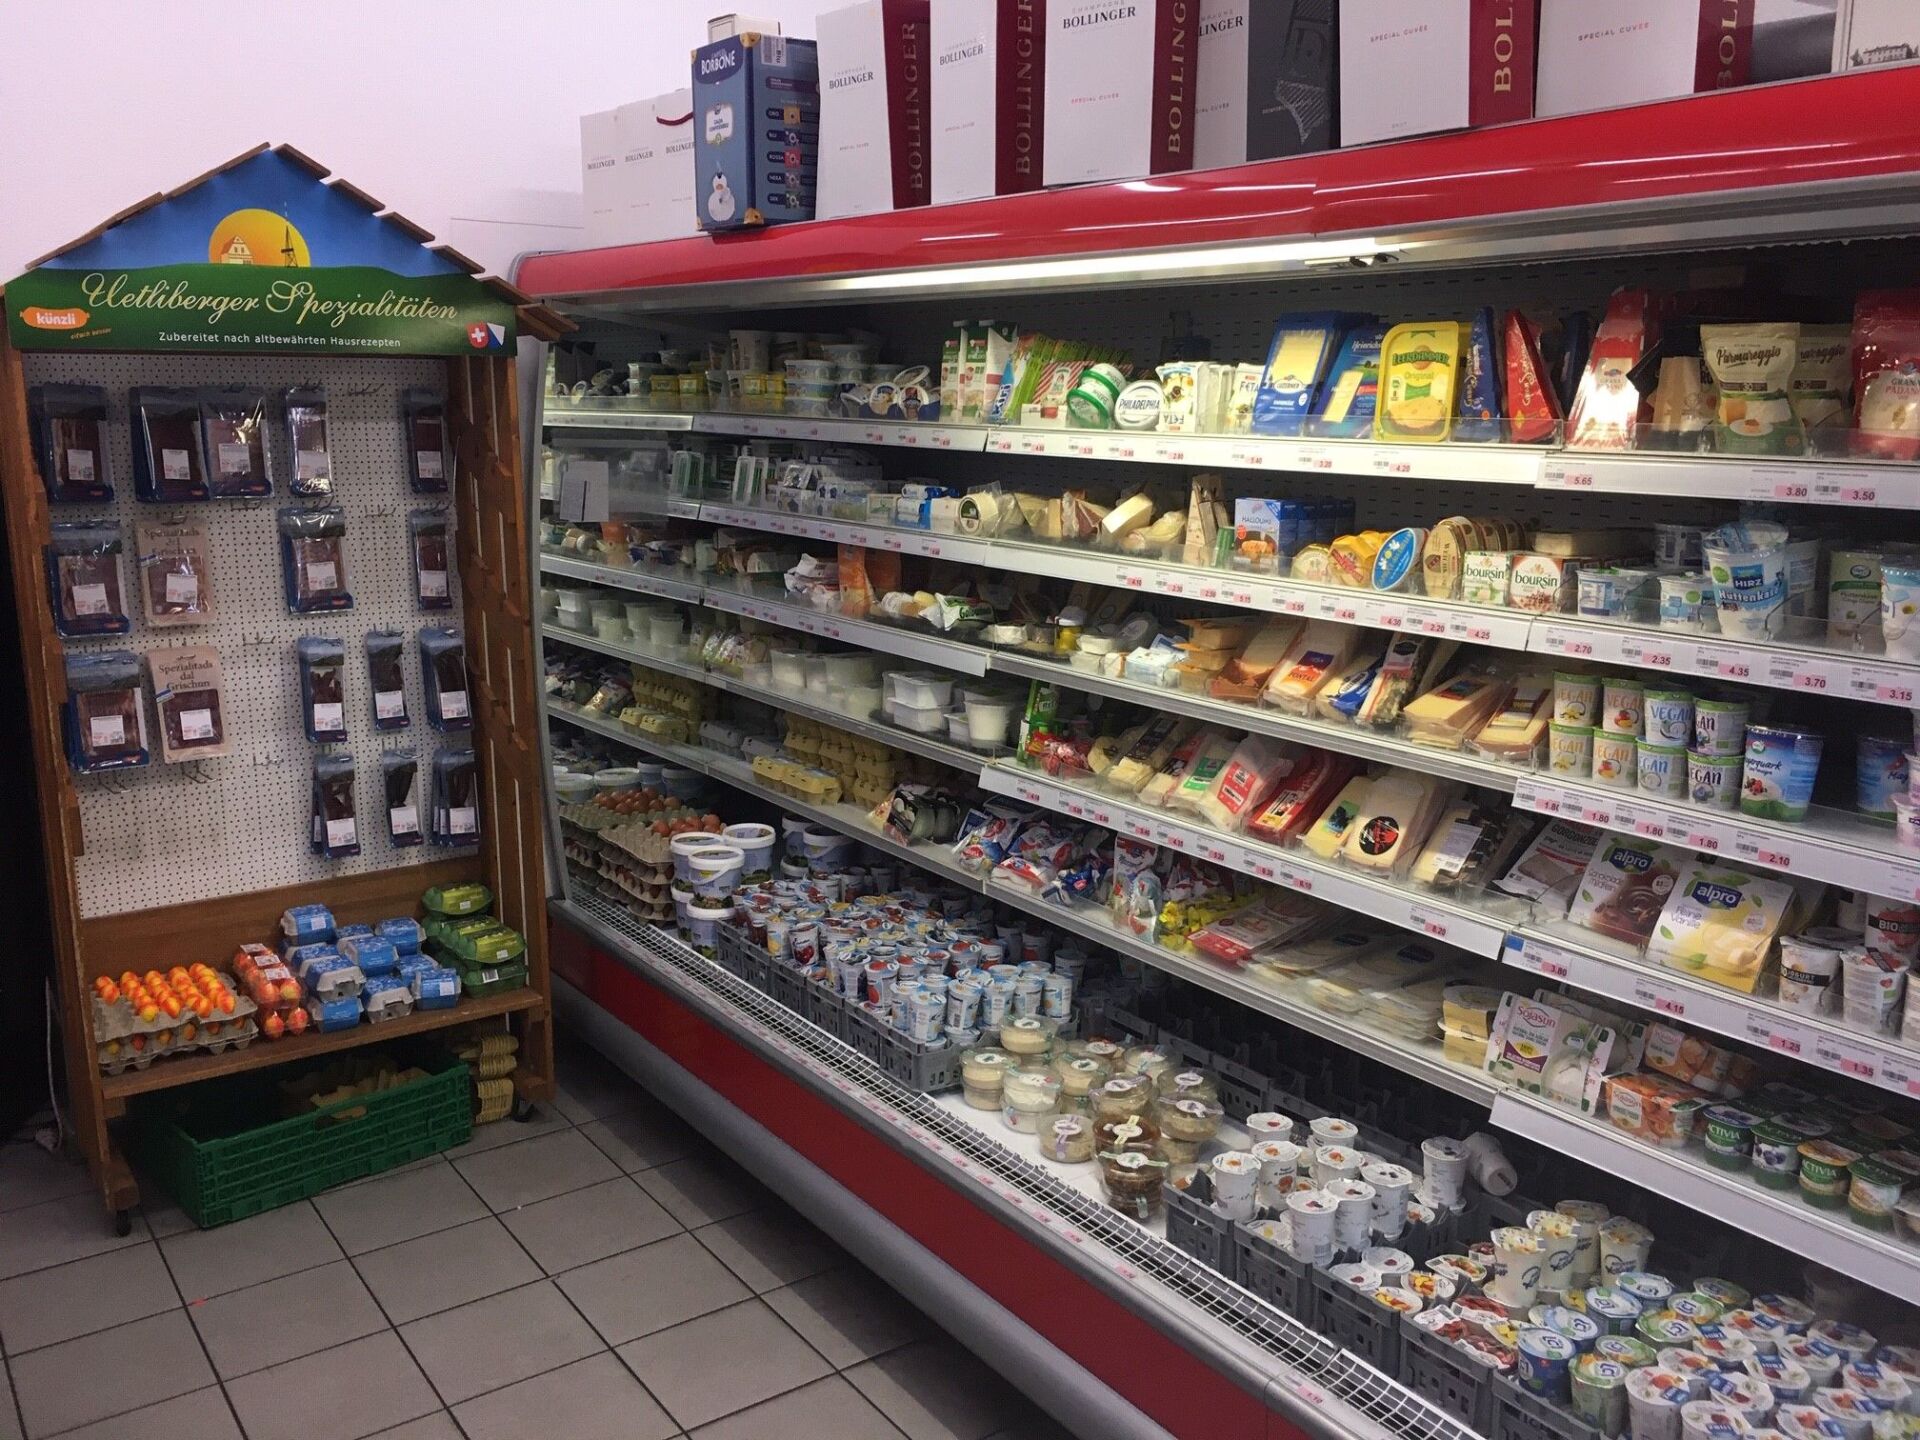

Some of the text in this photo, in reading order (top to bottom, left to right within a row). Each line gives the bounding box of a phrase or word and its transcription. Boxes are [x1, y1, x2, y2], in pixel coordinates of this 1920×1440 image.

[1063, 6, 1136, 29] BOLLINGER
[939, 44, 984, 66] BOLLINGER
[702, 50, 736, 75] BORBONE
[829, 71, 874, 90] BOLLINGER
[902, 22, 923, 189] BOLLINGER
[81, 272, 458, 329] Uetliberger Spezialitäten
[36, 312, 76, 326] künzli
[159, 332, 401, 349] Zubereitet nach altbewährten Hausrezepten
[1118, 399, 1160, 411] PHILADELPHIA
[1396, 465, 1411, 473] 4.20
[1574, 477, 1592, 486] 5.65
[1786, 487, 1808, 497] 3.80
[1852, 491, 1875, 501] 3.50
[1465, 564, 1505, 581] boursin
[1514, 571, 1558, 588] boursin
[1735, 578, 1763, 588] HIRZ
[1430, 625, 1445, 633] 2.20
[1475, 631, 1490, 640] 4.25
[1575, 644, 1592, 654] 2.70
[1652, 654, 1671, 665] 2.35
[180, 671, 195, 681] dal
[1729, 667, 1750, 677] 4.35
[1804, 677, 1826, 689] 3.70
[1890, 689, 1912, 701] 3.15
[1592, 813, 1610, 824] 1.80
[1645, 826, 1663, 837] 1.80
[1699, 838, 1718, 850] 1.80
[1613, 850, 1649, 868] alpro
[1770, 854, 1790, 866] 2.10
[1697, 885, 1736, 903] alpro
[1879, 920, 1898, 932] BIO
[1666, 1002, 1684, 1014] 4.15
[1516, 1005, 1556, 1028] Sojasun
[1854, 1063, 1874, 1077] 1.35
